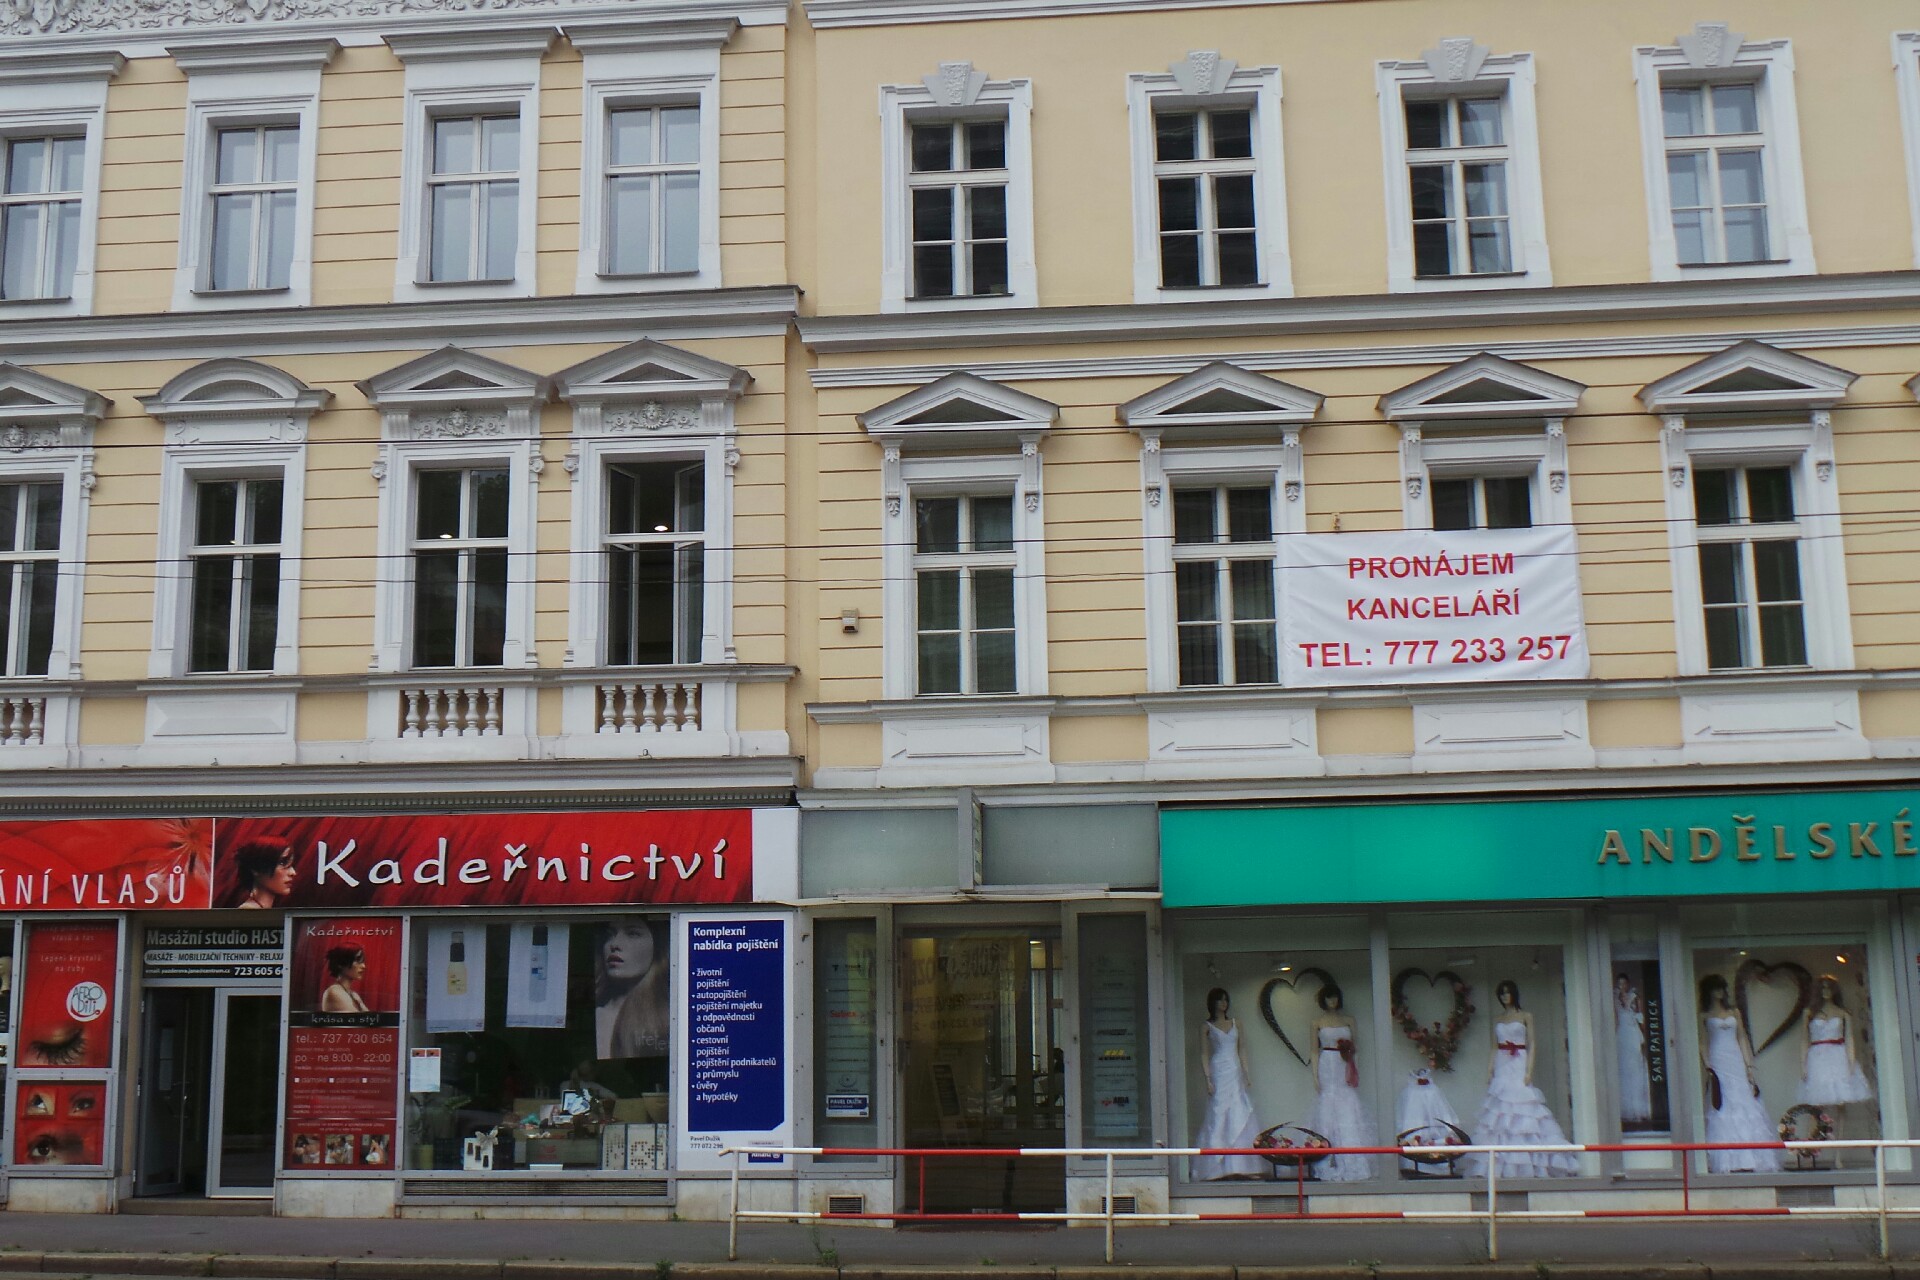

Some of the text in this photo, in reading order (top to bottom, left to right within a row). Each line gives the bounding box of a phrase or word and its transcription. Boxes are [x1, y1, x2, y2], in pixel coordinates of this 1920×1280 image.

[1348, 550, 1514, 579] PRONÁJEM
[1347, 588, 1520, 620] KANCELÁŘÍ
[1299, 635, 1572, 668] TEL: 777 233 257
[1597, 807, 1919, 865] ANDĚLSKÉ
[317, 837, 728, 888] Kadeřnictví
[71, 865, 186, 904] VLASŮ
[306, 925, 394, 937] Kadeřnictví
[693, 926, 746, 939] Komplexní
[146, 929, 201, 945] Masážní
[204, 929, 248, 945] studio
[693, 939, 779, 952] nabídka pojištění
[147, 952, 174, 961] MASÁŽE
[178, 952, 221, 961] MOBILIZAČNÍ
[222, 952, 256, 961] TECHNIKY
[234, 967, 253, 976] 723
[254, 967, 273, 976] 605
[274, 967, 283, 976] 6
[696, 968, 723, 977] životní
[696, 979, 730, 989] pojištění
[696, 990, 747, 1001] autopojištění
[696, 1001, 763, 1012] pojištění majetku
[311, 1013, 343, 1023] krása
[360, 1014, 380, 1026] styl
[702, 1012, 755, 1023] odpovědnosti
[696, 1024, 725, 1033] občanů
[322, 1033, 342, 1044] 737
[347, 1033, 368, 1044] 730
[372, 1033, 392, 1044] 654
[696, 1035, 729, 1044] cestovní
[1648, 1000, 1663, 1082] SAN PATRICK
[696, 1047, 730, 1057] pojištění
[294, 1054, 307, 1064] po
[363, 1053, 391, 1063] 22:00
[696, 1057, 777, 1068] pojištění podnikatelů
[702, 1069, 739, 1080] průmyslu
[696, 1081, 718, 1091] úvěry
[702, 1092, 738, 1103] hypotéky
